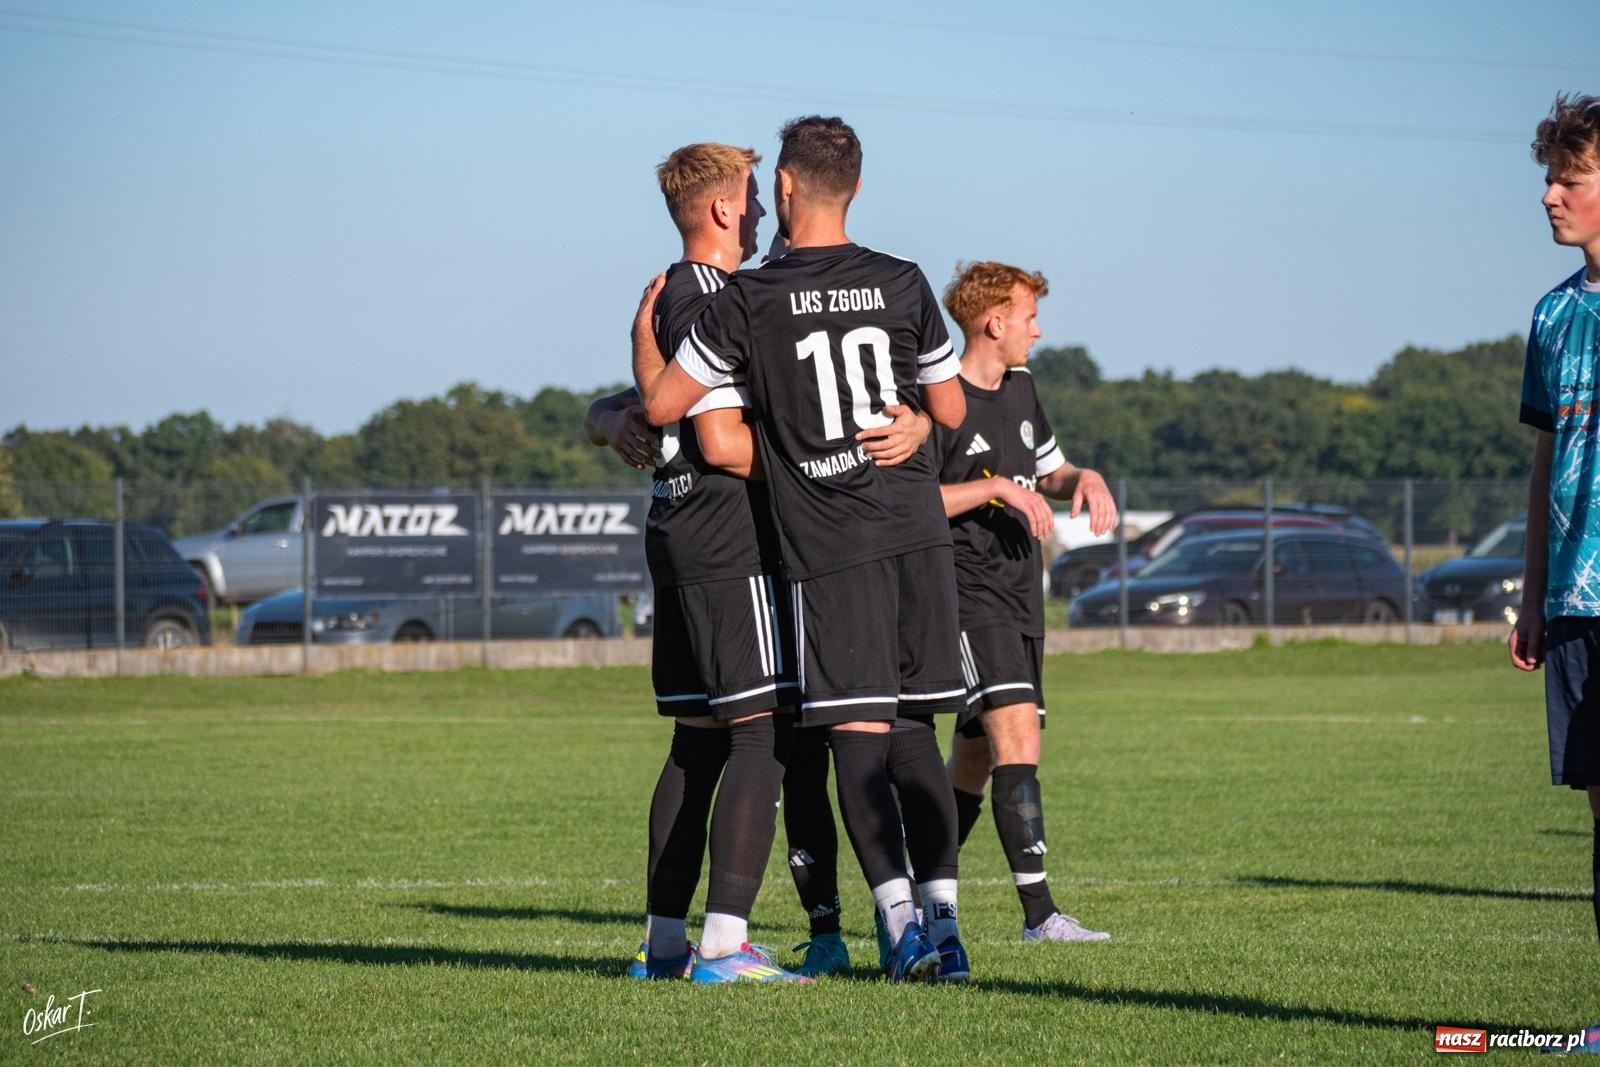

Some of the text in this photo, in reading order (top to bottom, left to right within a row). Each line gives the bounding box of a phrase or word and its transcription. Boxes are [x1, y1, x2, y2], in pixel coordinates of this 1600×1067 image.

[790, 287, 886, 315] LKS ZGODA
[796, 326, 900, 441] 10
[799, 445, 872, 479] ZAWADA K
[321, 503, 470, 537] MATOZ
[498, 503, 640, 535] MATOZ
